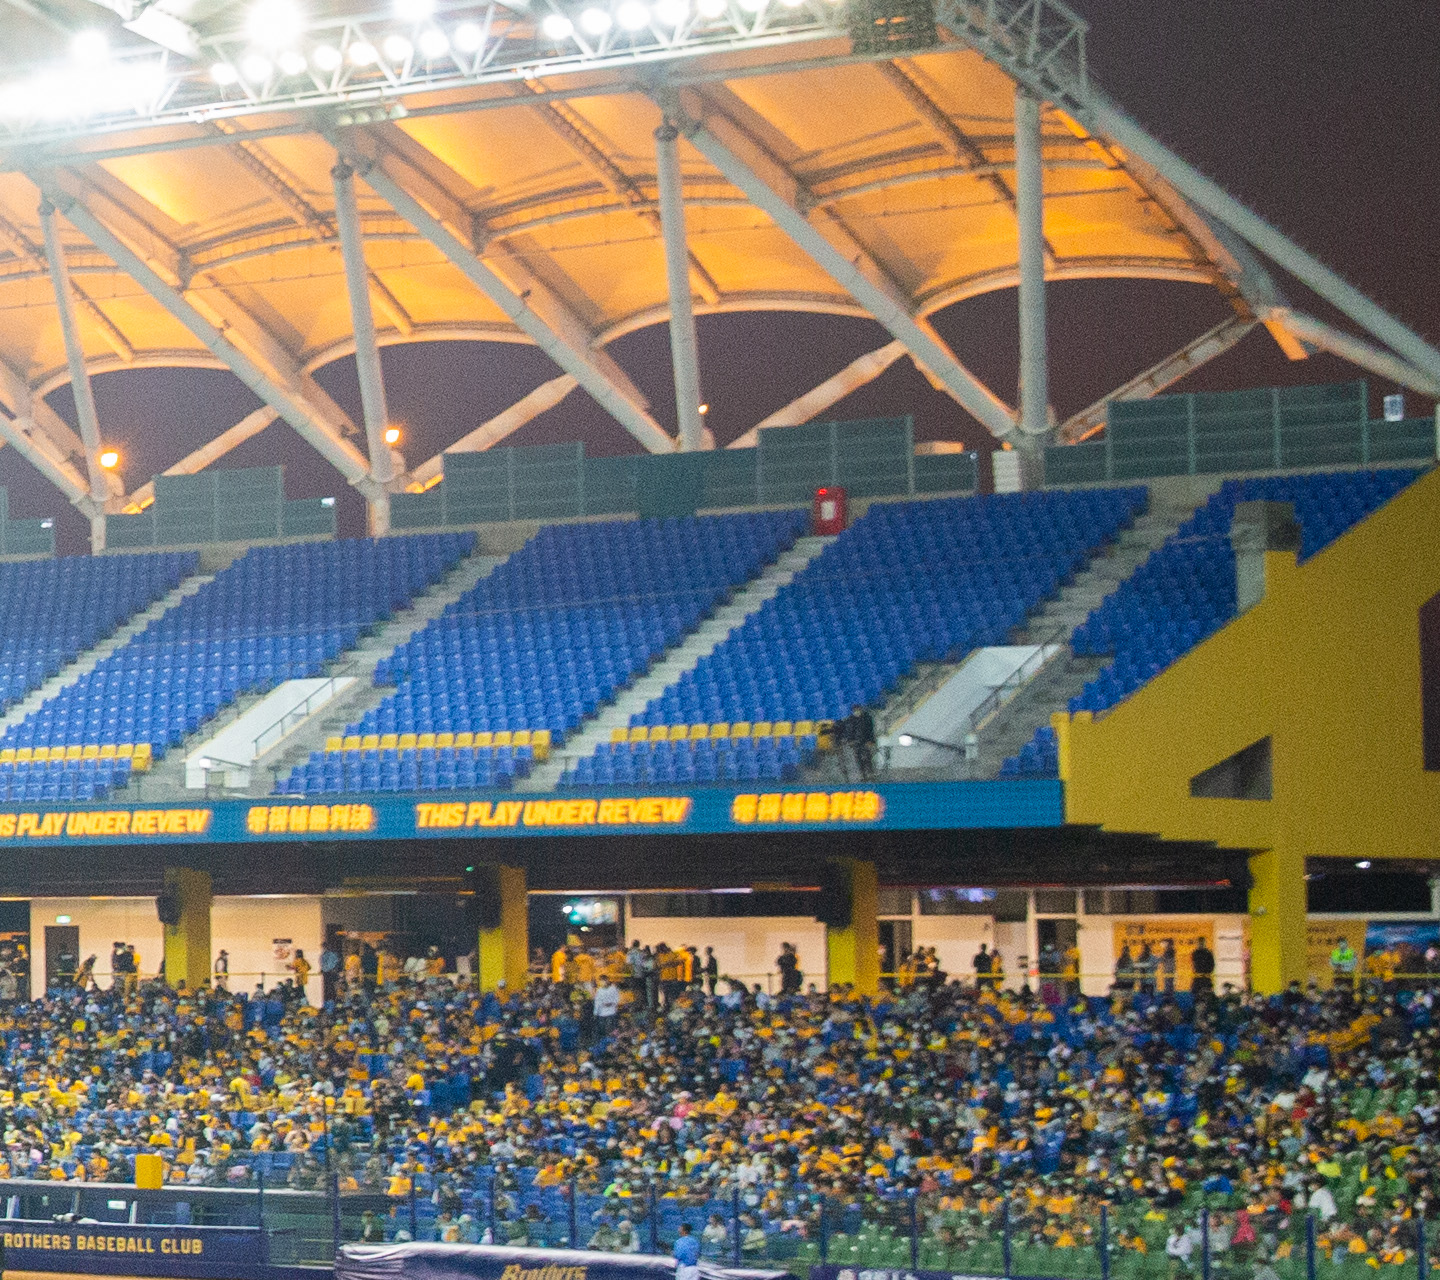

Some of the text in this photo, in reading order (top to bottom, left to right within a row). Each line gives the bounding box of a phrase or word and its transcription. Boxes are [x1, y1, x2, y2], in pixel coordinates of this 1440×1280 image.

[17, 813, 67, 836] PLAY
[67, 812, 132, 836] UNDER
[132, 809, 210, 834] REVIEW
[416, 797, 692, 828] THIS PLAY UNDER REVIEW
[3, 1232, 204, 1254] ROTHERS BASEBALL CLUB
